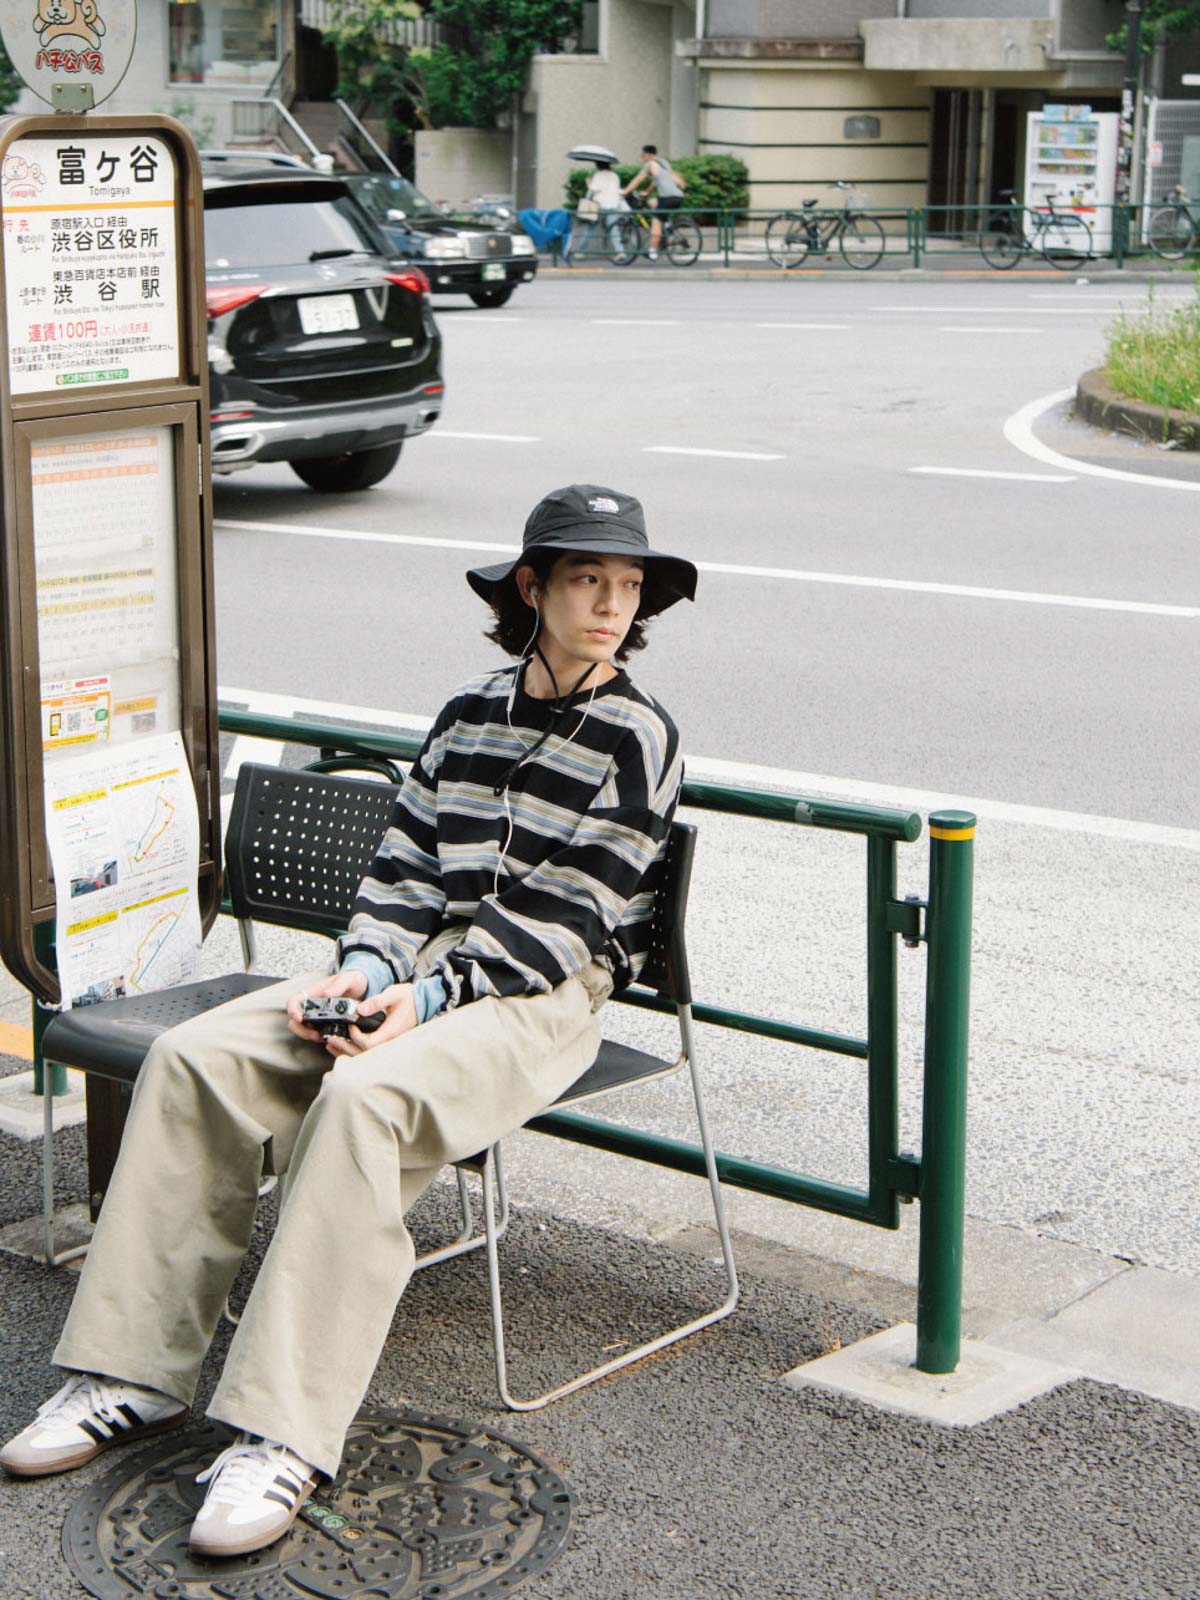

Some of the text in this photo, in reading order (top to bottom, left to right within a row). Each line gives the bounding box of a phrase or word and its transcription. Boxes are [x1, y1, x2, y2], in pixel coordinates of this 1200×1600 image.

[35, 49, 104, 74] ハチ公バス
[89, 186, 131, 199] Tomigaya
[51, 215, 128, 230] 原宿駅入口 経由
[52, 227, 159, 252] 渋谷区役所
[53, 265, 160, 282] 東急百貨店本店前 経由
[53, 278, 160, 305] 渋谷駅
[28, 320, 97, 343] 運賃100円
